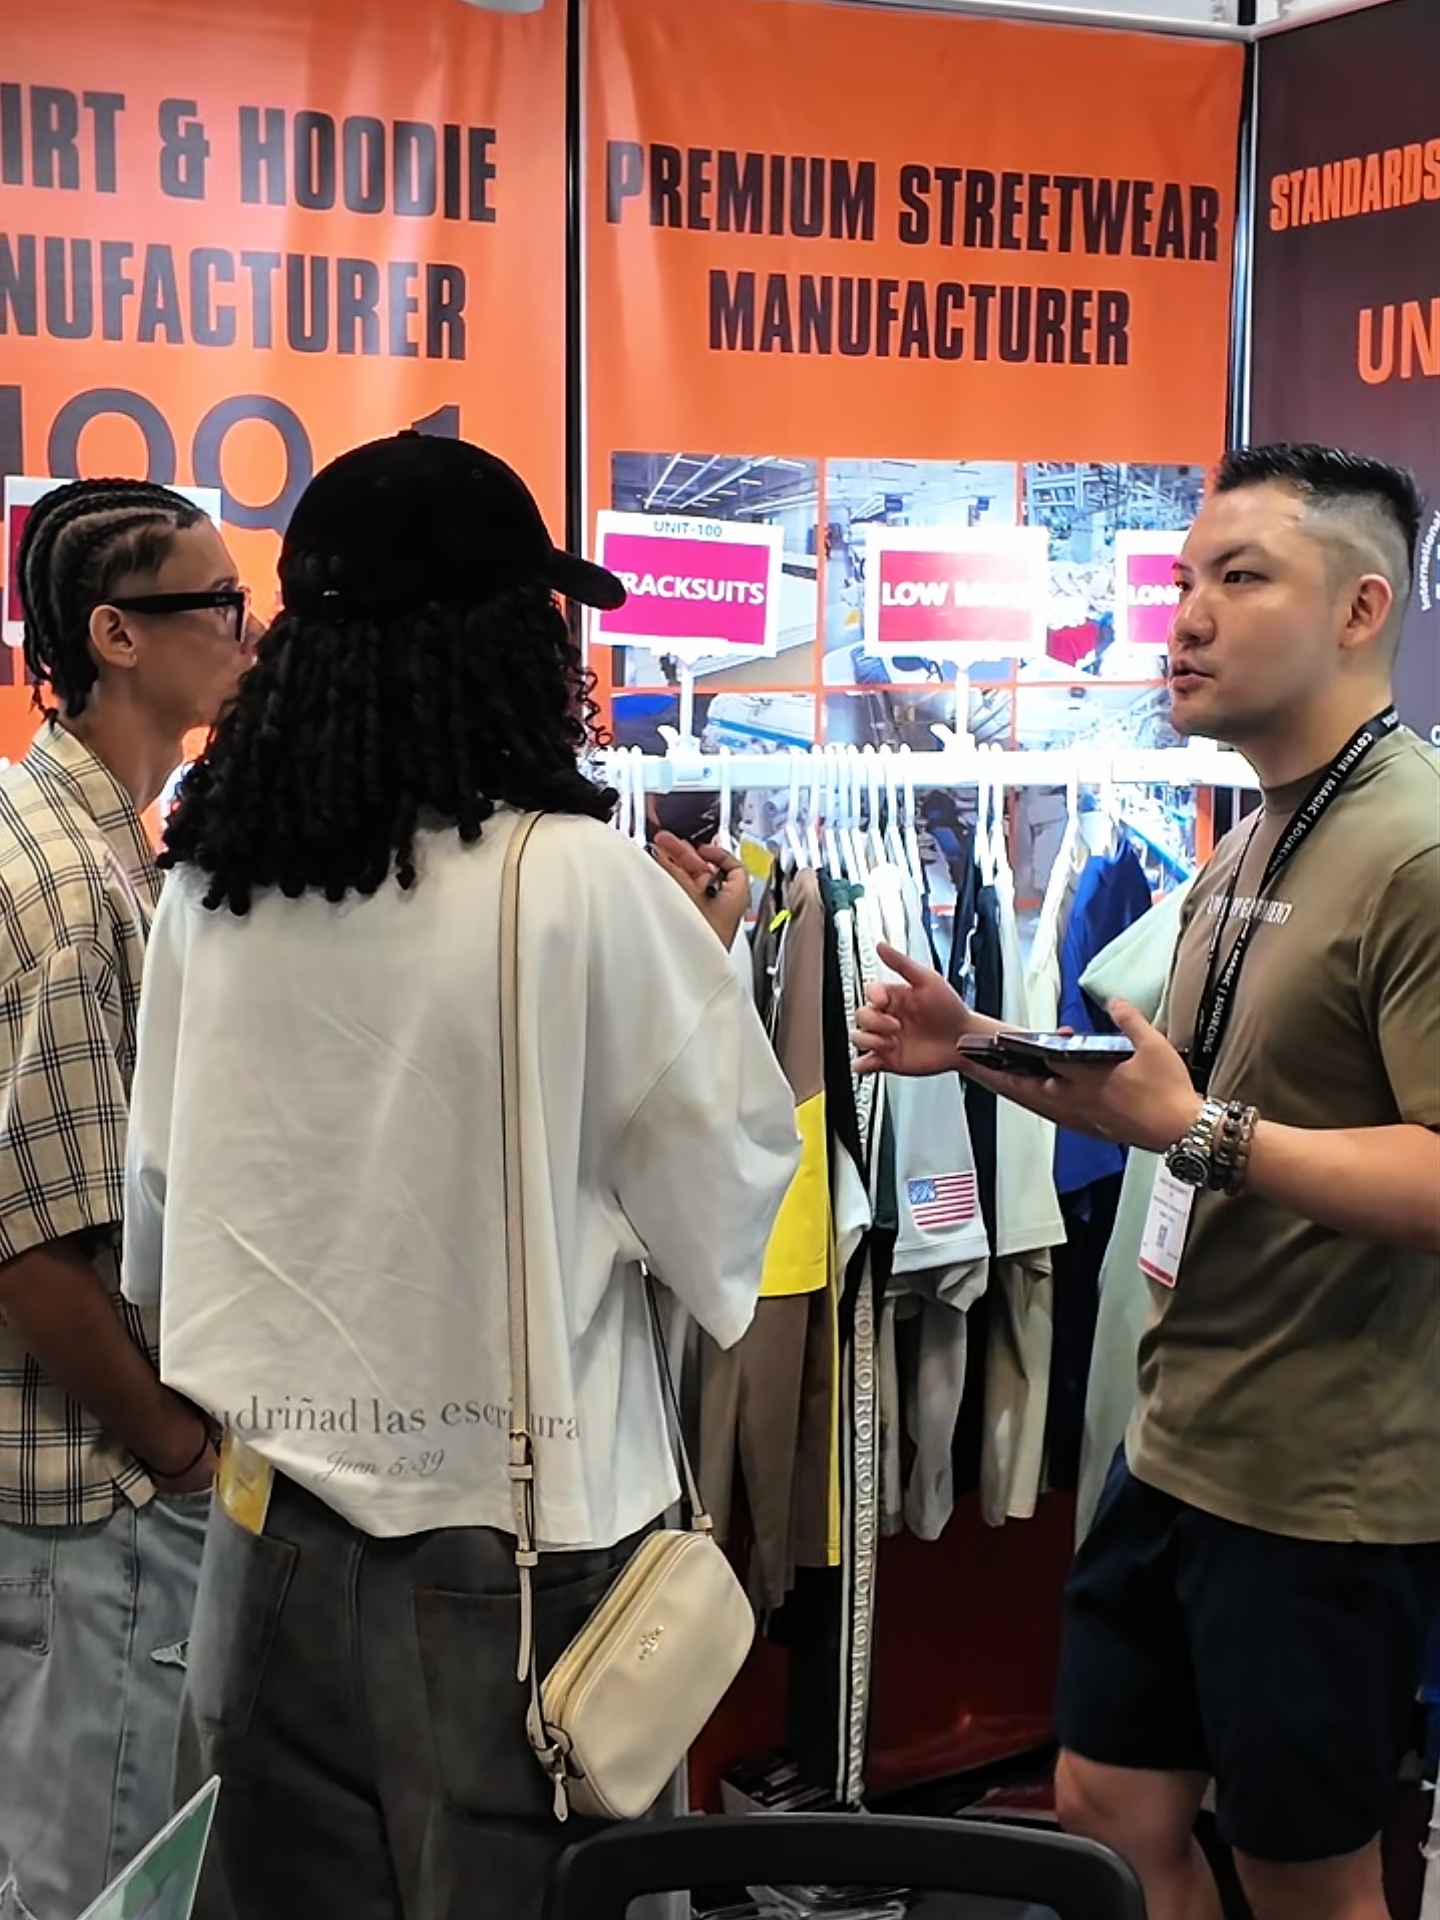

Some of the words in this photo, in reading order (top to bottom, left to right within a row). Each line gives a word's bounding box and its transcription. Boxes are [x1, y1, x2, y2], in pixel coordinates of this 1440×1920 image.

[0, 83, 125, 193] IRT
[158, 97, 210, 200] &
[238, 105, 497, 223] HOODIE
[1269, 138, 1440, 231] STANDARDS
[606, 140, 876, 242] PREMIUM
[899, 164, 1220, 262] STREETWEAR
[0, 232, 467, 361] NUFACTURER
[709, 268, 1129, 366] MANUFACTURER
[653, 520, 723, 538] UNIT-100
[881, 581, 949, 607] LOW
[1306, 778, 1337, 816] MAGIC
[371, 1397, 426, 1435] las
[440, 1396, 581, 1441] escriura
